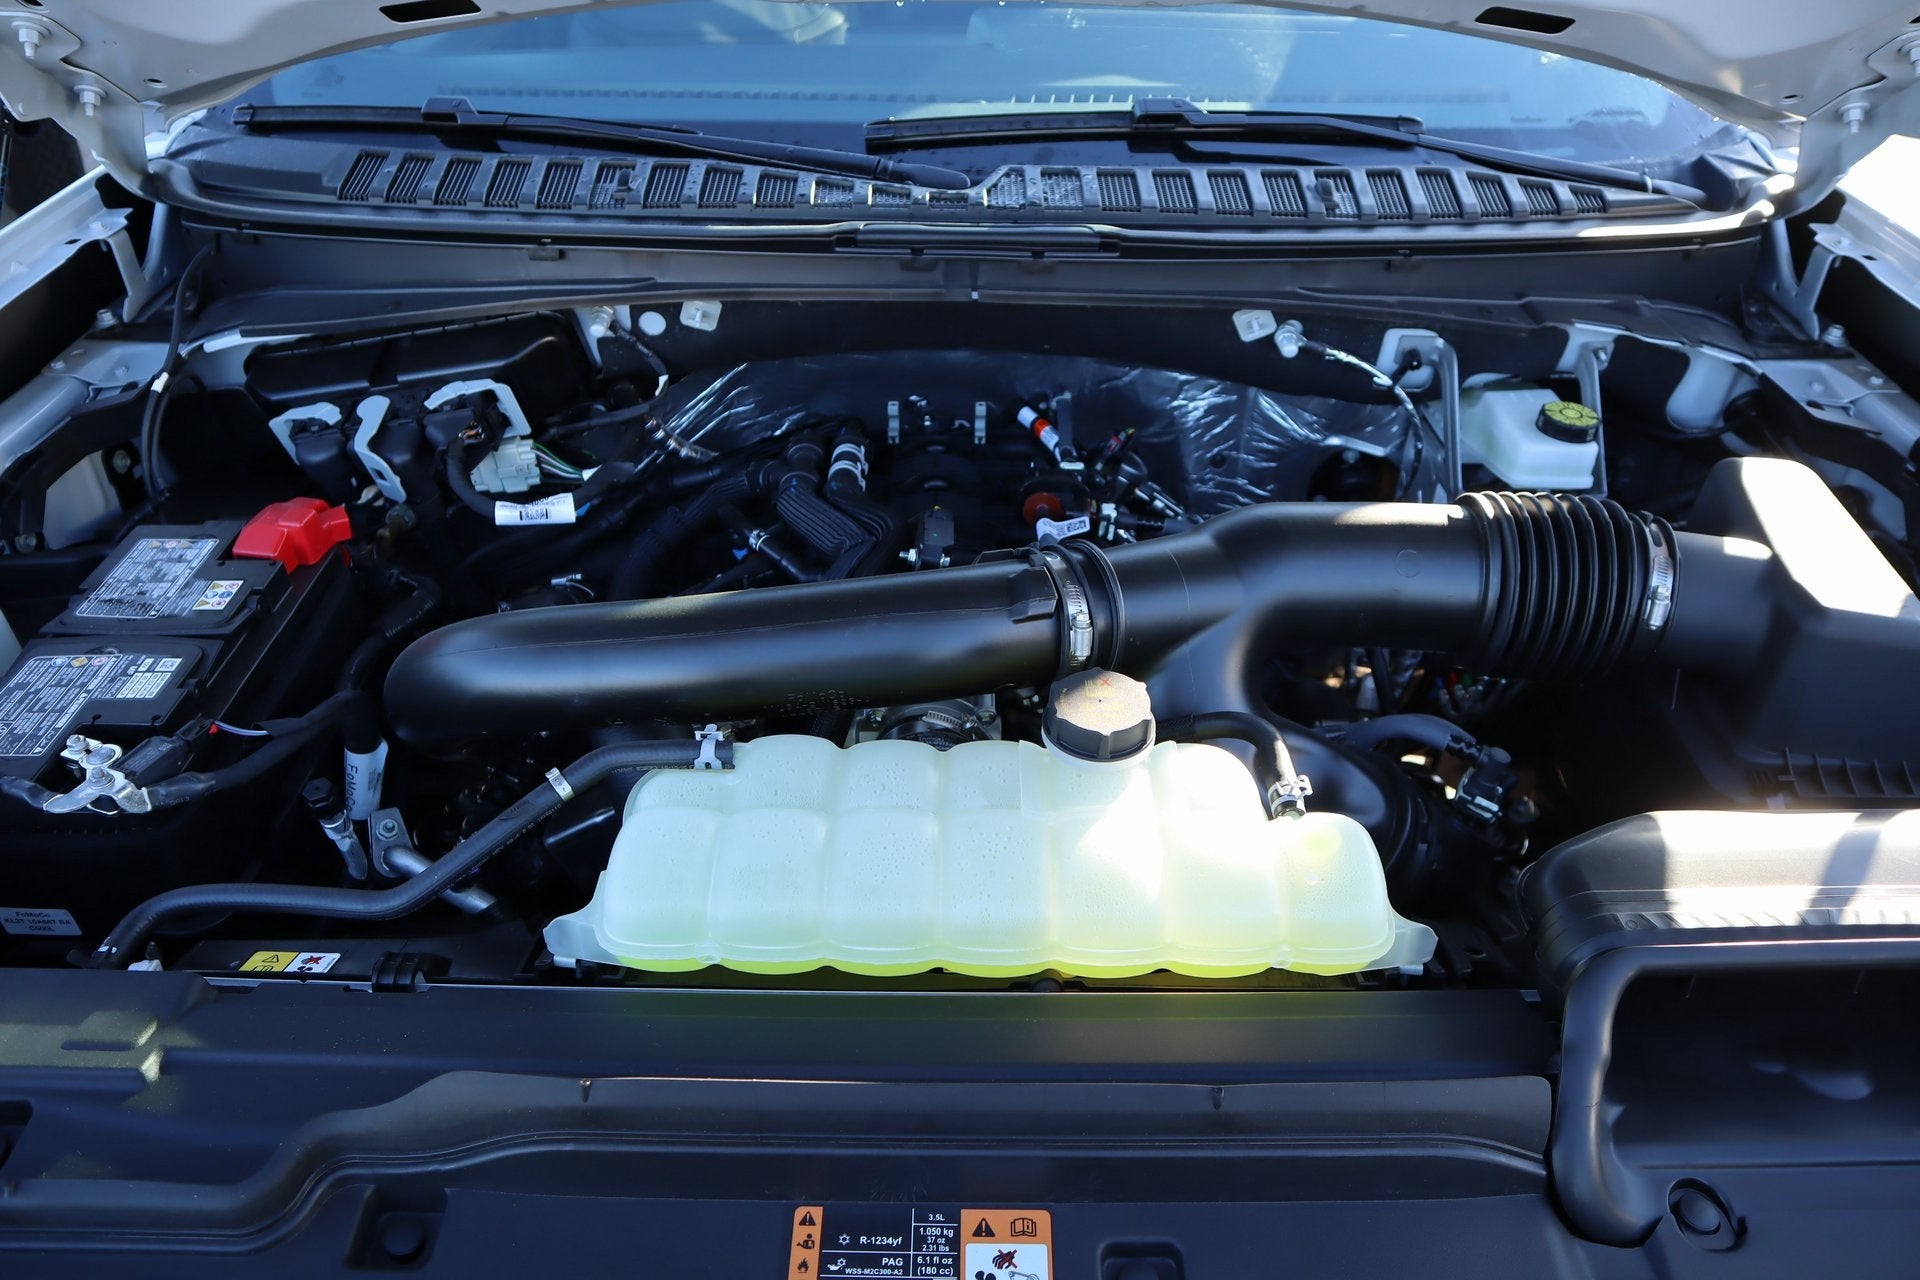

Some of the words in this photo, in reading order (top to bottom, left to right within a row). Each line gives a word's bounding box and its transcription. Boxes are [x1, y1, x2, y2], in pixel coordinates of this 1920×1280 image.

[346, 763, 358, 814] FoMoCo
[919, 1227, 941, 1236] 1.050
[942, 1228, 954, 1238] kg
[859, 1236, 902, 1247] R-1234yf
[922, 1244, 938, 1252] 2.31
[938, 1244, 950, 1252] lbs
[882, 1257, 904, 1266] PAG
[917, 1256, 930, 1265] 6.1
[932, 1256, 940, 1265] fl
[941, 1257, 953, 1265] oz
[917, 1265, 938, 1276] (180
[938, 1265, 954, 1276] cc)
